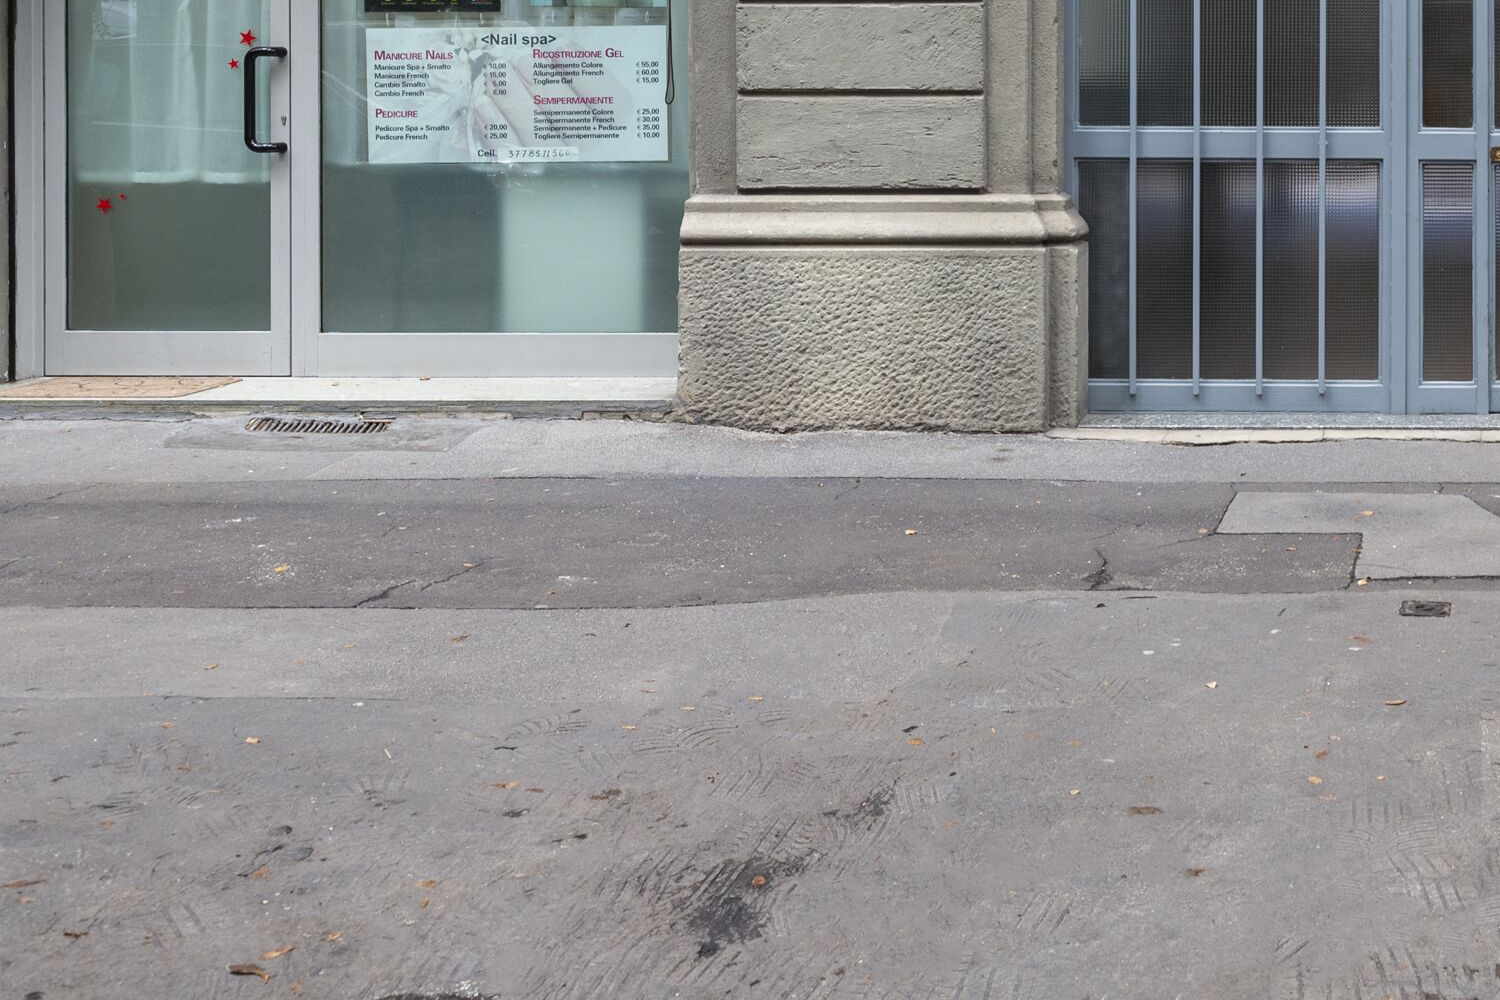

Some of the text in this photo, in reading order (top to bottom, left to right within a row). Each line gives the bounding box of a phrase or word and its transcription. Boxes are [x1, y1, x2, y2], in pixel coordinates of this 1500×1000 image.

[374, 49, 453, 60] MANICURE NAILS
[532, 47, 624, 59] RICOSTRUZIONE GEL
[406, 63, 419, 71] Spa
[533, 62, 580, 70] Allungamento
[533, 95, 614, 105] SEMIPERMANENTE
[375, 108, 418, 118] PEDICURE
[533, 109, 591, 117] Semipermanente
[405, 125, 418, 133] Spa
